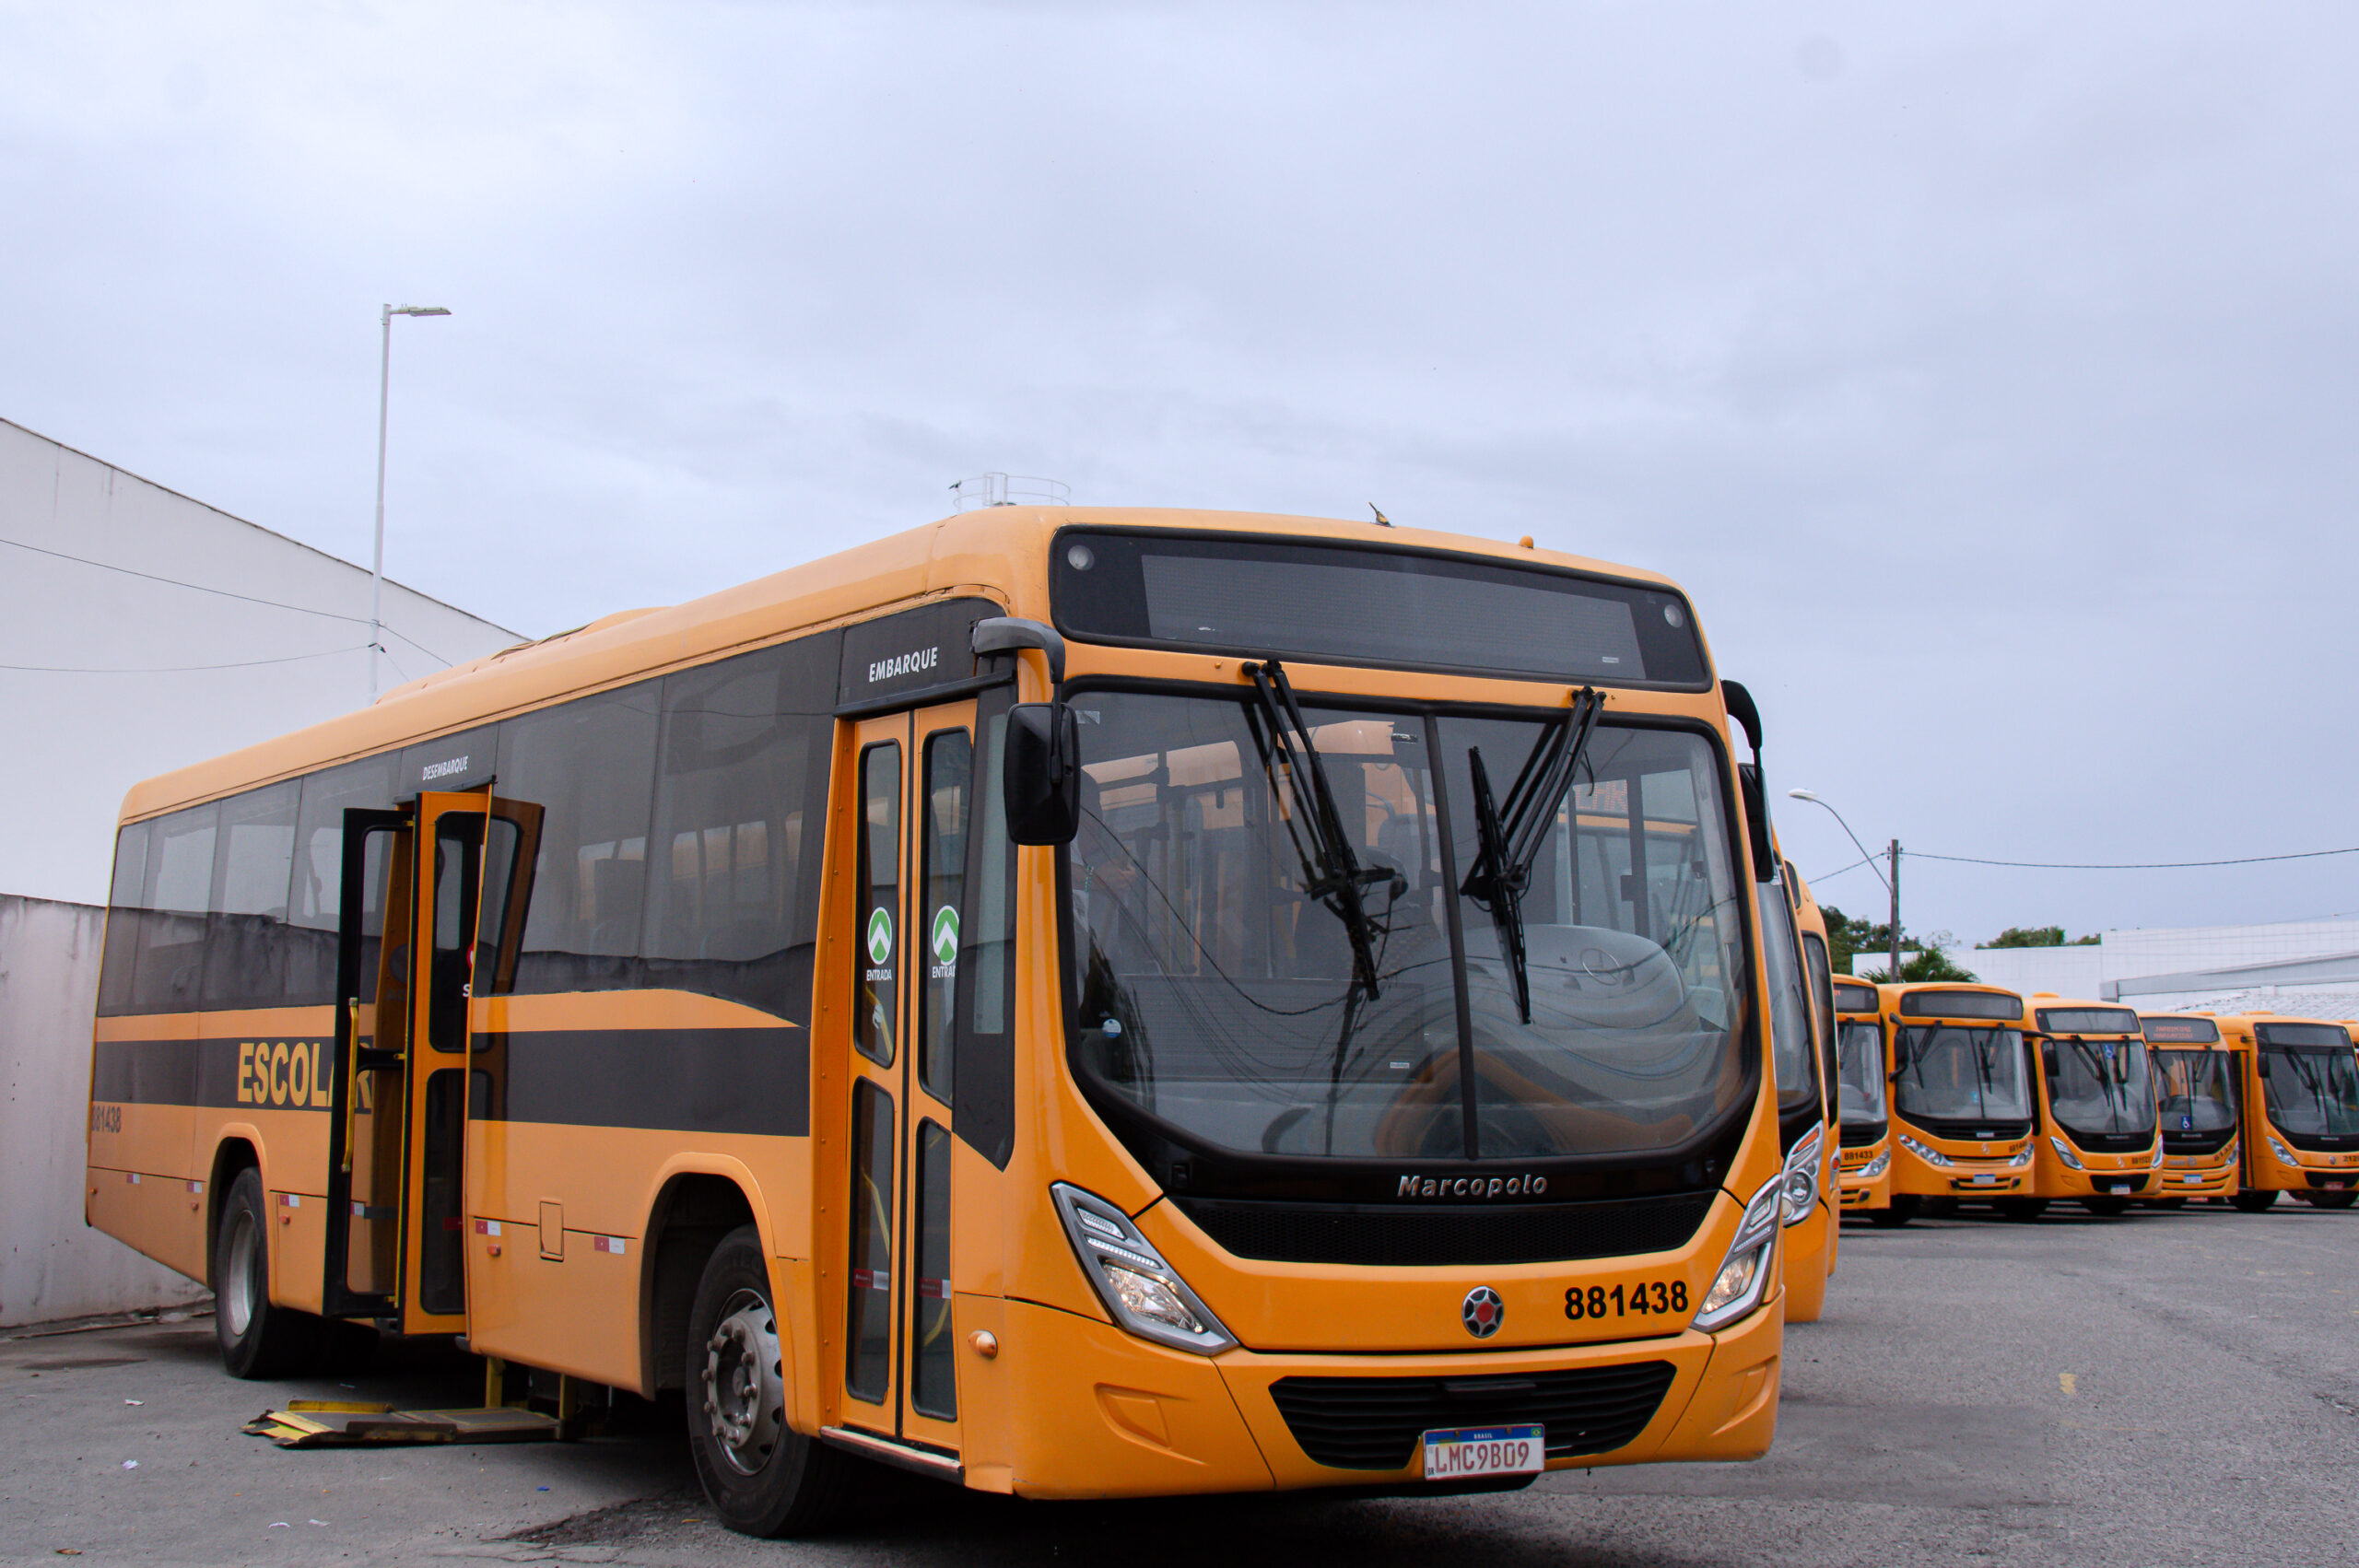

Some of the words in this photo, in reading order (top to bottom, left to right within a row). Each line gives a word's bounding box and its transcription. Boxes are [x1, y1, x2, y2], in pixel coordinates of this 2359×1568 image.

[868, 647, 938, 683] EMBARQUE
[422, 755, 468, 781] DESEMBARQUE
[866, 968, 892, 981] ENTRADA
[237, 1042, 373, 1109] ESCOL
[90, 1106, 122, 1133] 881438
[1844, 1150, 1873, 1161] 881433
[1397, 1174, 1548, 1198] Marcopolo
[1564, 1280, 1689, 1320] 881438
[1435, 1442, 1530, 1472] LMC9B09
